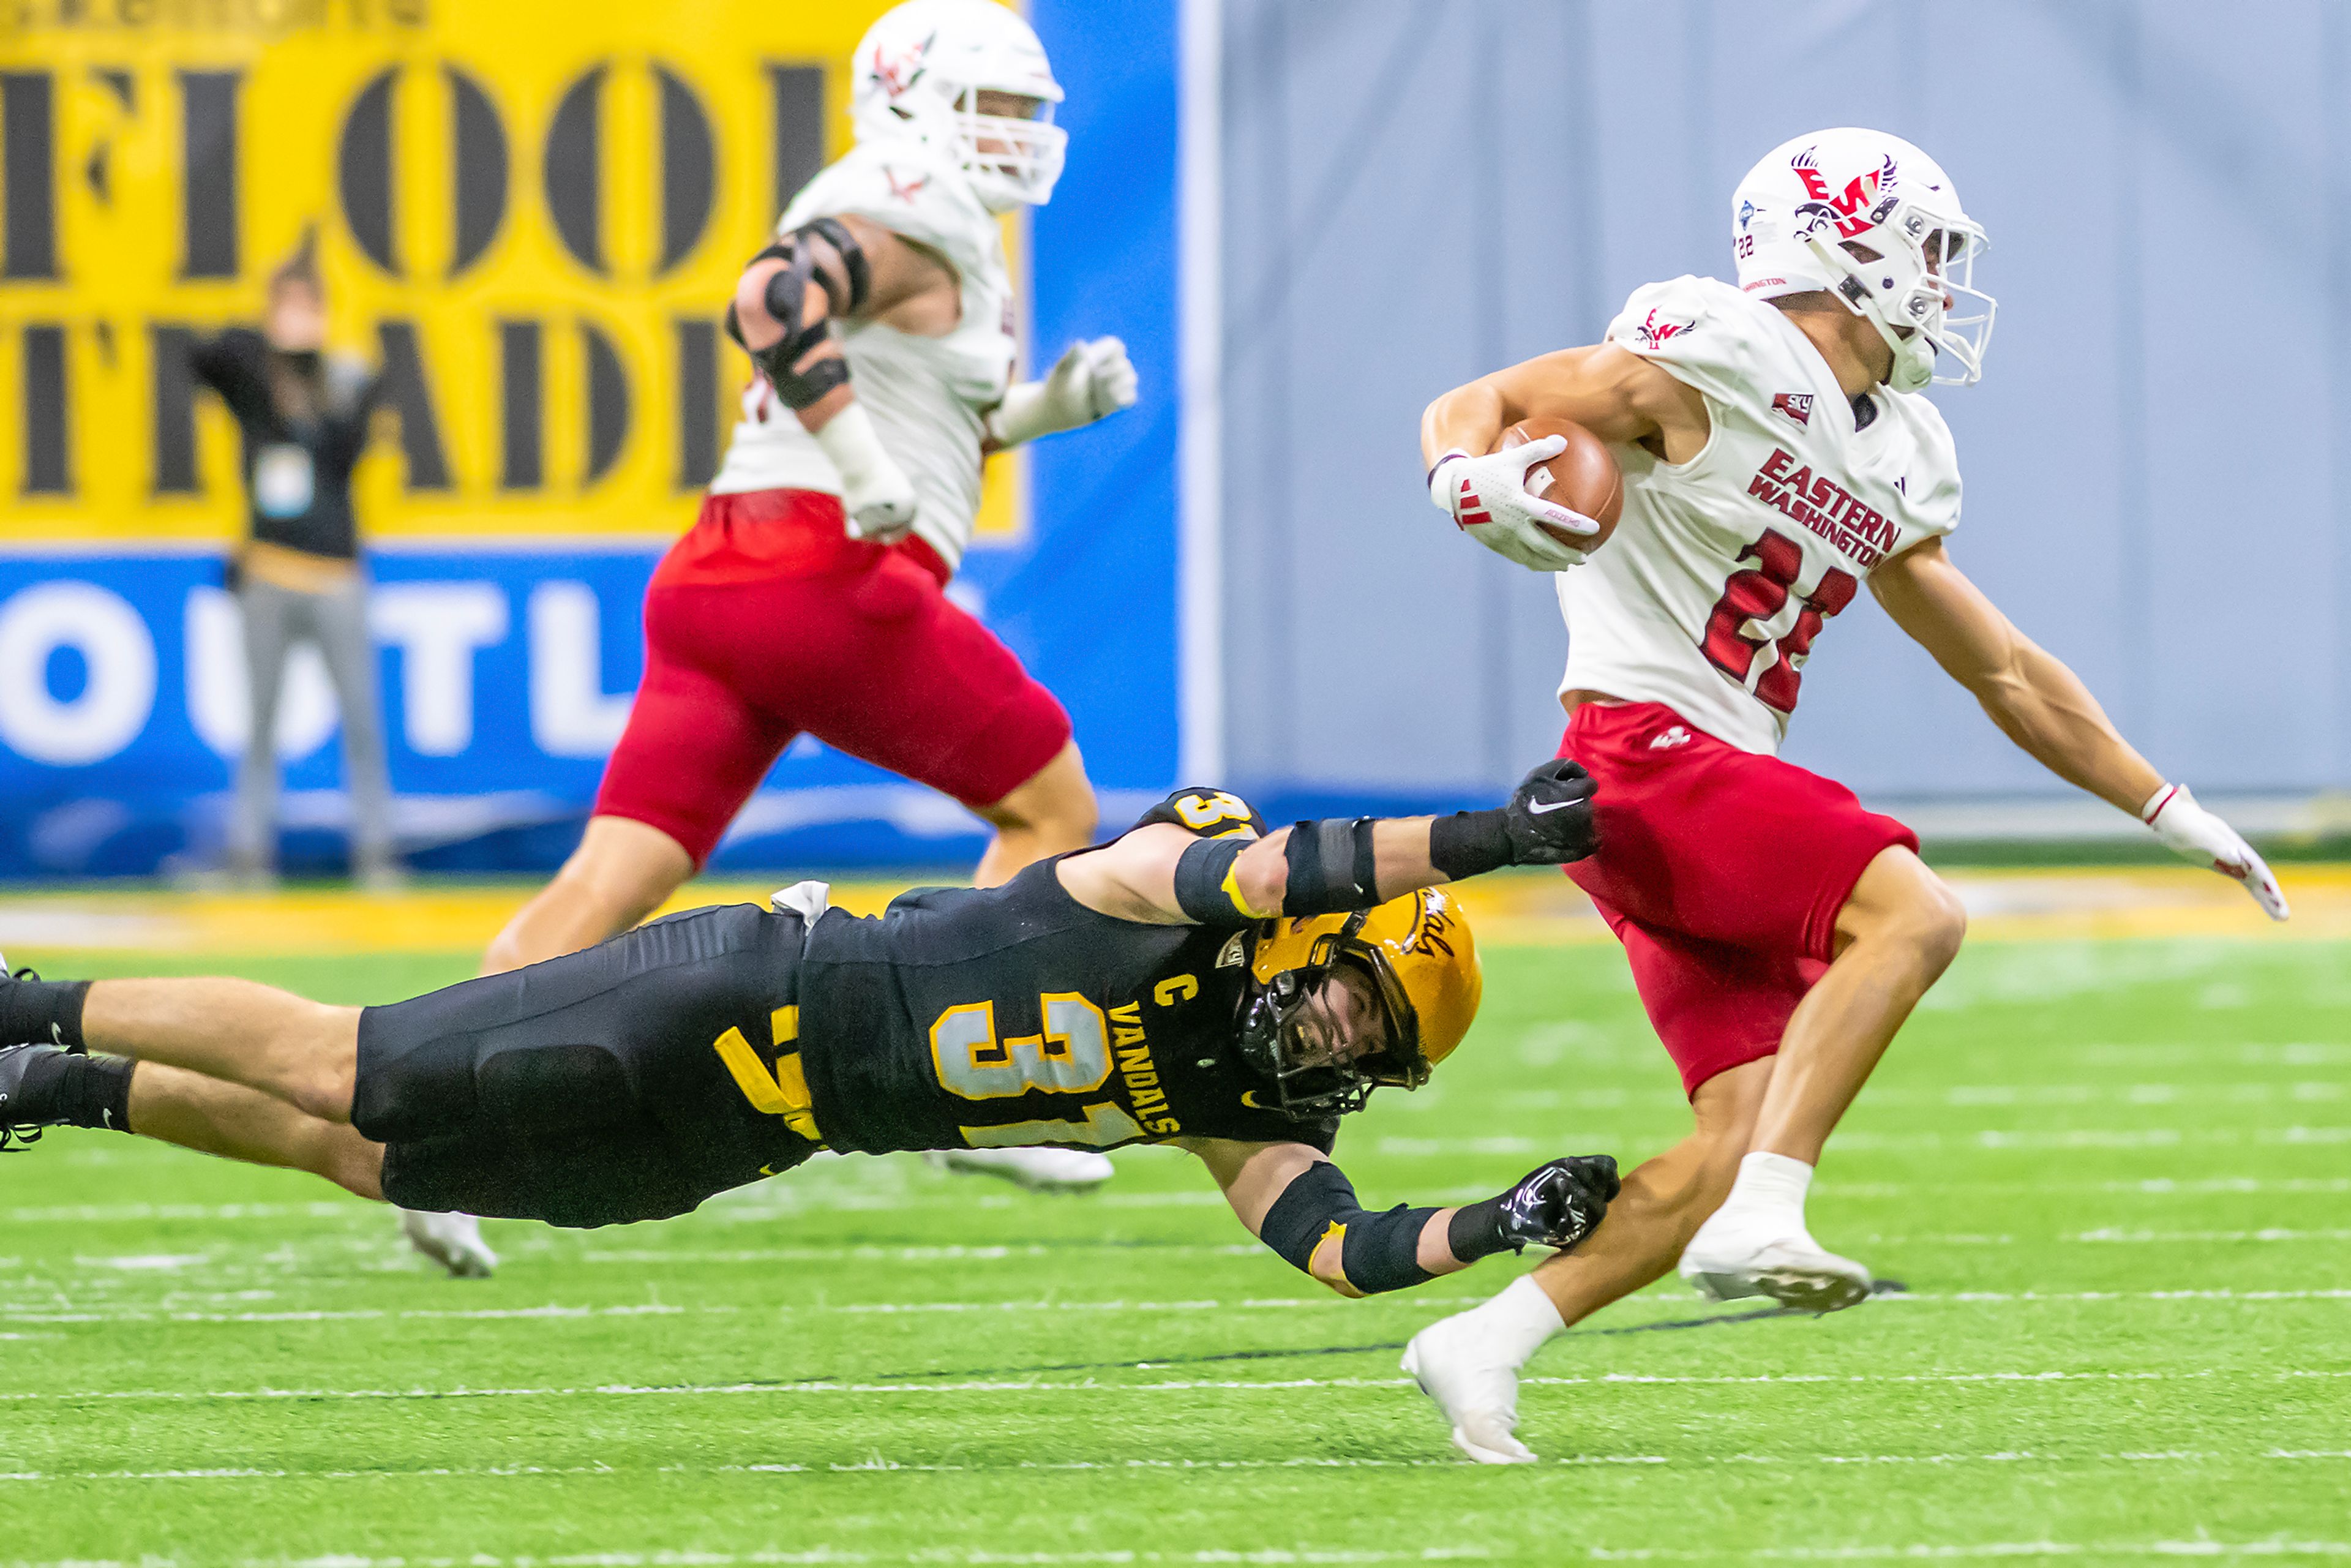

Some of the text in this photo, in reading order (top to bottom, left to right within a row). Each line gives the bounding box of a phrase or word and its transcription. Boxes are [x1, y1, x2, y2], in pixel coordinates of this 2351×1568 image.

[1739, 234, 1753, 260] 22
[1759, 448, 1902, 553] EASTERN
[1699, 527, 1858, 715] 22
[1153, 973, 1199, 1007] C
[929, 991, 1149, 1149] 31
[1108, 1000, 1181, 1134] VANDALS
